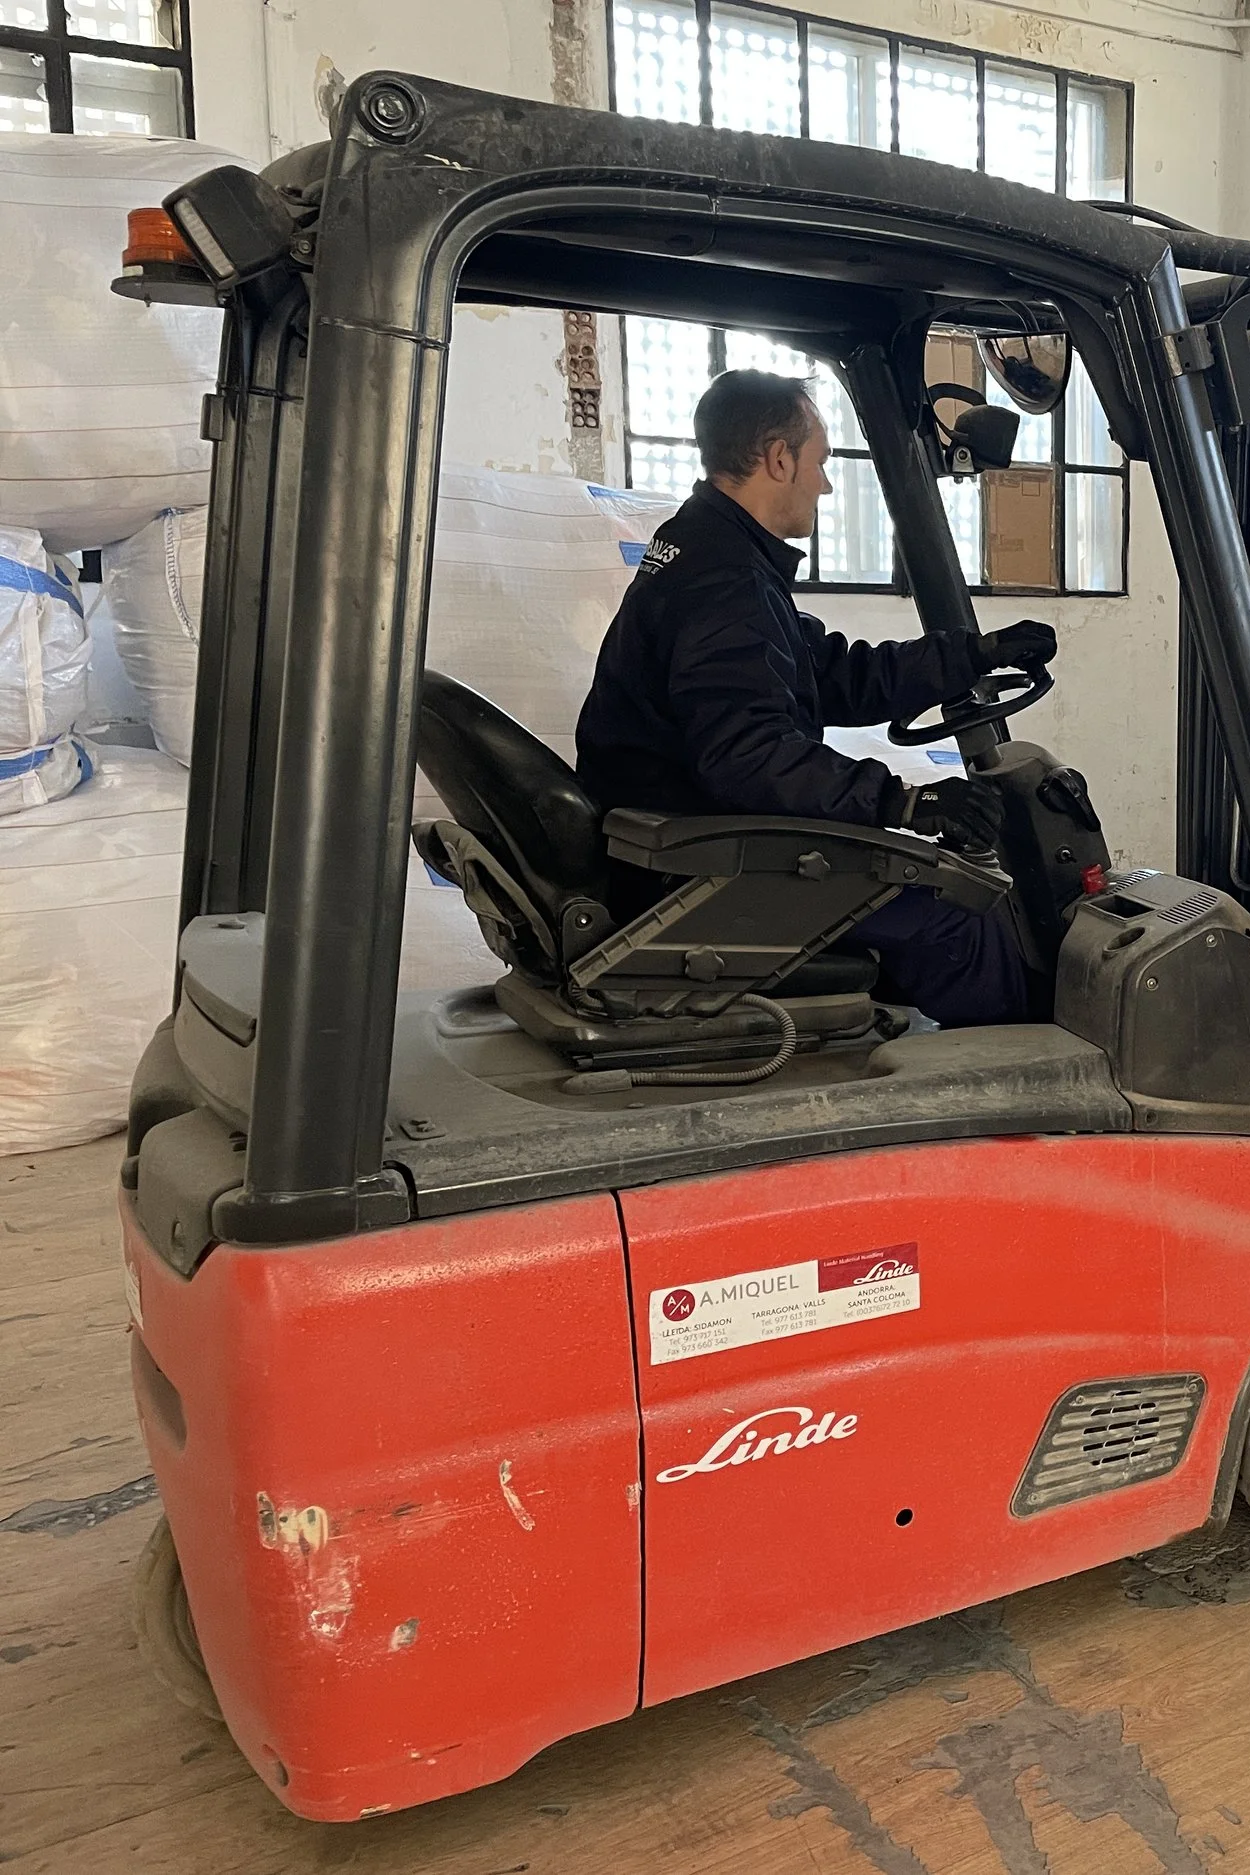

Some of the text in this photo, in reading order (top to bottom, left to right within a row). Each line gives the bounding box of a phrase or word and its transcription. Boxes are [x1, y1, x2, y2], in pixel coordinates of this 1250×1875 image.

[853, 1259, 914, 1285] Linde
[699, 1274, 799, 1308] A.MIQUEL
[847, 1291, 906, 1309] SANTA COLOMA
[802, 1298, 826, 1309] VALLS
[693, 1317, 732, 1331] SIDAMON
[656, 1406, 858, 1483] Linde
